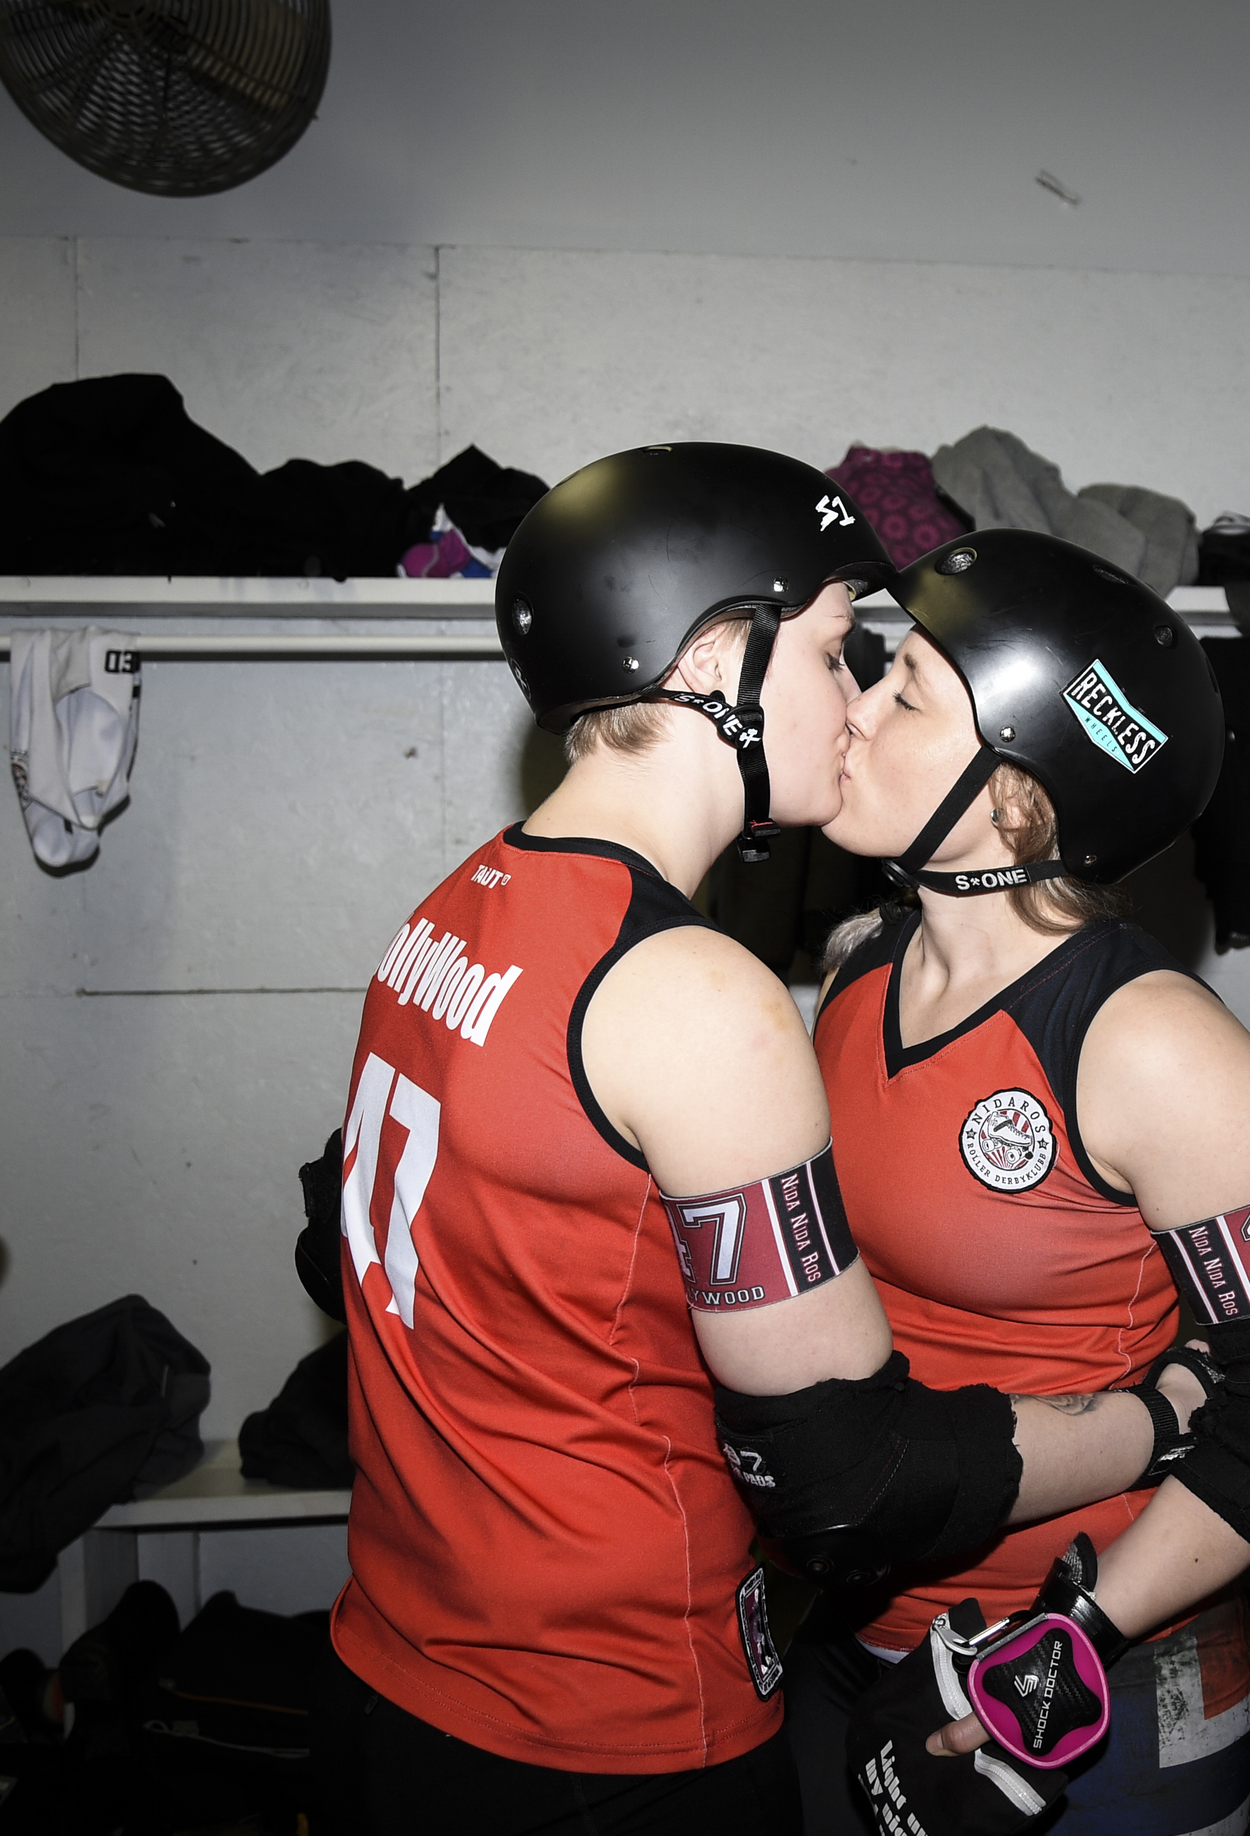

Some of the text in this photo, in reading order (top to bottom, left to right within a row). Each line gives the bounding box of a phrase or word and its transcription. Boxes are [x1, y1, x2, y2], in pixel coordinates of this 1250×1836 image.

[1070, 672, 1156, 765] RECKLESS
[1085, 716, 1118, 753] WHEELS
[376, 917, 524, 1047] ollyWood
[971, 1096, 1046, 1134] NIDAROS
[967, 1142, 1047, 1186] ROLLER DERBYKLUBB
[688, 1285, 766, 1306] YWOOD
[1044, 1640, 1064, 1699] DOCTOR
[1033, 1700, 1052, 1749] SHOCK
